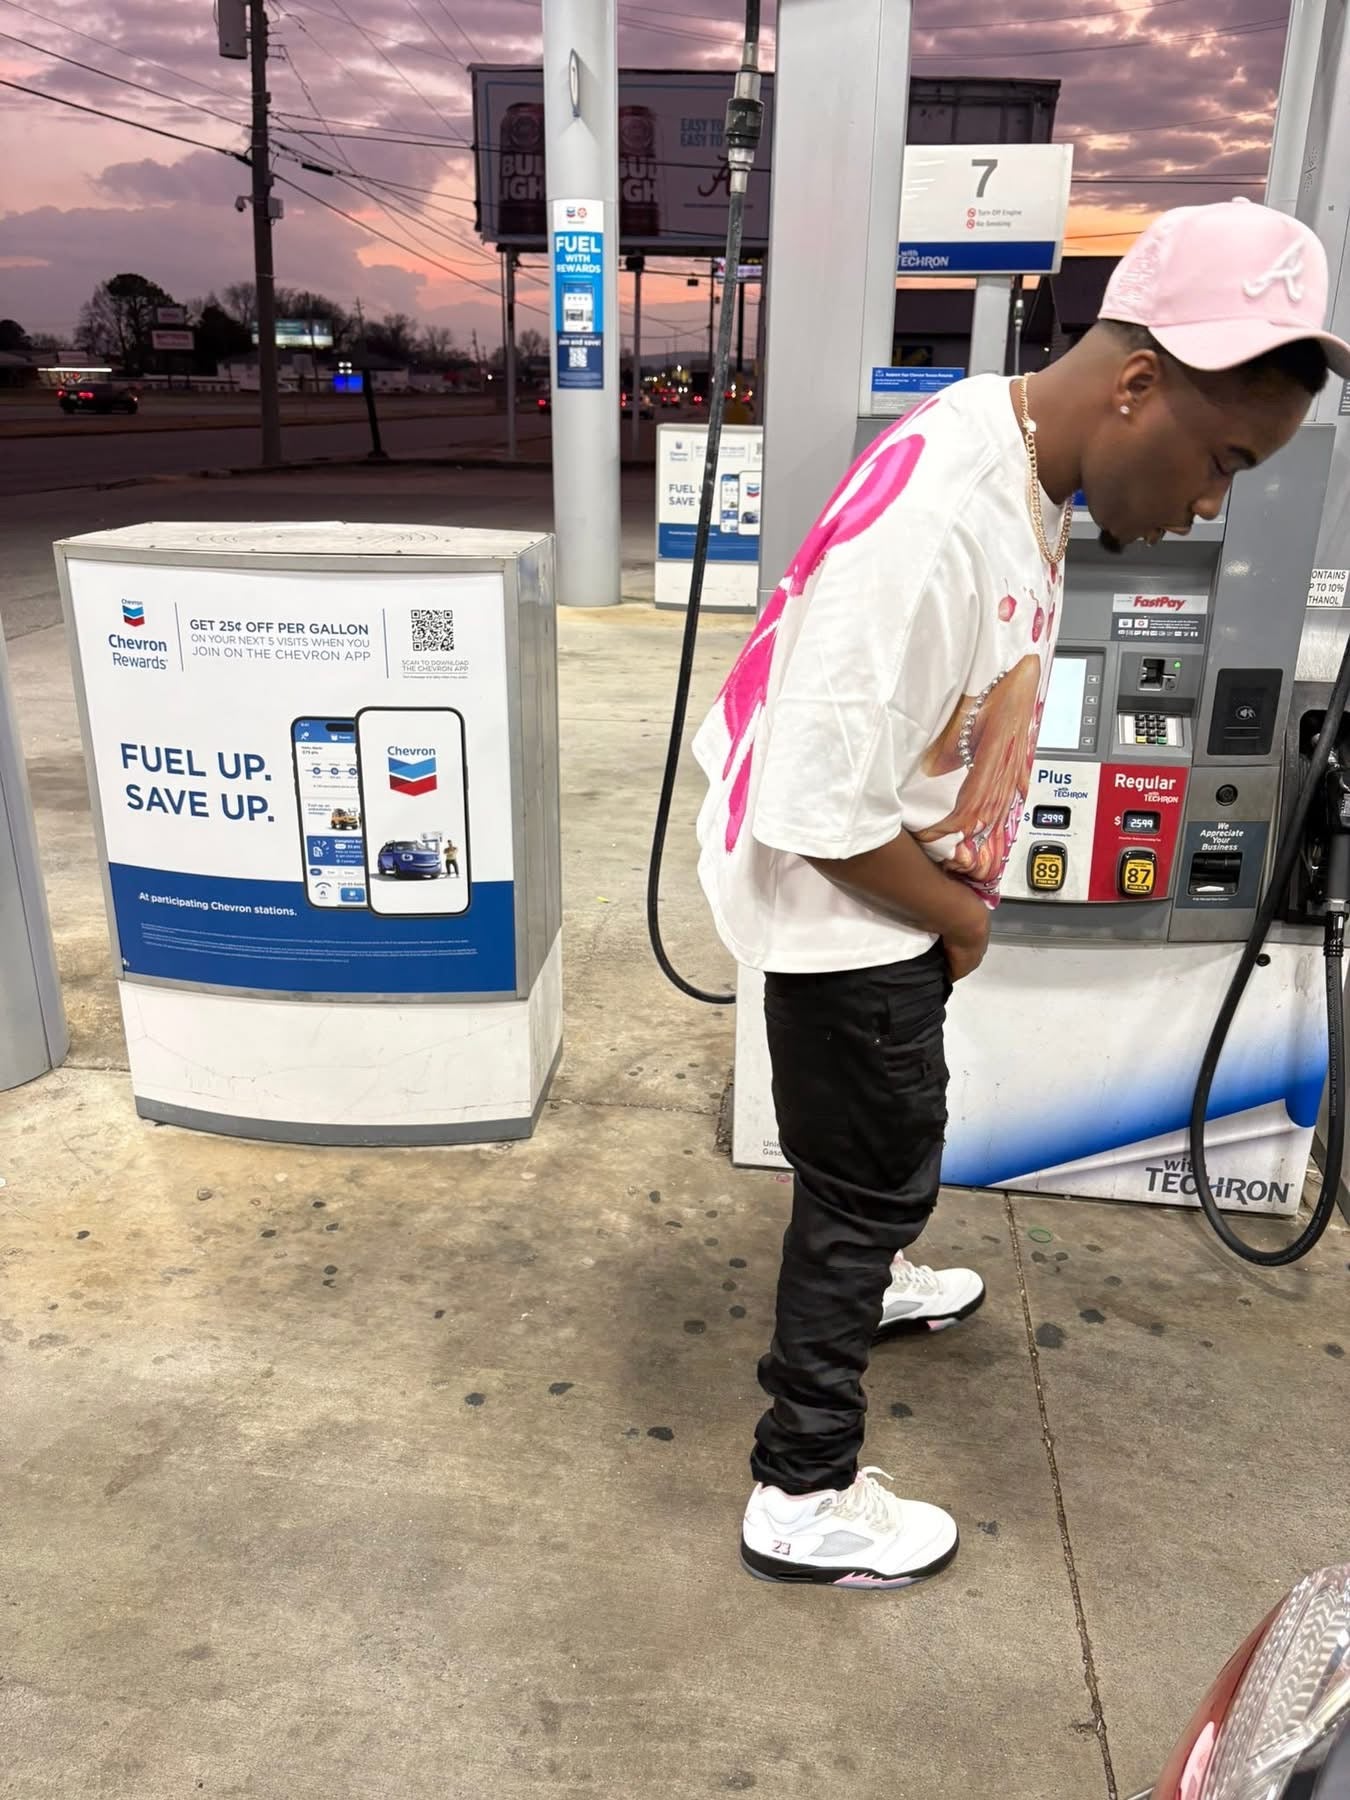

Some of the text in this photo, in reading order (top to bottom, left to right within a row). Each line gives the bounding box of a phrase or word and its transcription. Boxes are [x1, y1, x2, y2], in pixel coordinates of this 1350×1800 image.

[971, 159, 998, 198] 7
[556, 235, 602, 253] FUEL
[565, 254, 591, 263] WITH
[669, 483, 696, 494] FUEL
[669, 497, 695, 507] SAVE
[1311, 570, 1346, 580] ONTAINS
[1316, 582, 1327, 592] TO
[1328, 583, 1345, 593] 10%
[121, 598, 144, 606] Chevron
[1134, 596, 1186, 611] FastPay
[1308, 595, 1339, 605] THANOL
[190, 619, 369, 635] GET 25¢ OFF PER GALLON
[108, 634, 167, 652] Chevron
[191, 634, 370, 648] ON YOUR NEXT 5 VISITS WHEN YOU
[192, 646, 371, 661] JOIN ON THE CHEVRON APP
[112, 652, 168, 670] Rewards
[387, 745, 436, 756] Chevron
[120, 743, 272, 781] FUEL UP.
[1037, 769, 1073, 785] Plus
[1114, 773, 1177, 791] Regular
[1053, 790, 1088, 800] TECHRON
[1144, 794, 1179, 804] TECHRON
[125, 784, 209, 818] SAVE
[221, 793, 275, 822] UP.
[1024, 812, 1031, 822] $
[1114, 815, 1121, 826] $
[1217, 822, 1230, 830] We
[1200, 829, 1245, 838] Appreciate
[1212, 836, 1231, 844] Your
[1201, 843, 1239, 851] Business
[1035, 862, 1060, 879] 89
[1127, 867, 1151, 885] 87
[139, 892, 298, 917] At participating Chevron stations.
[763, 1147, 783, 1156] Gaso
[1164, 1158, 1193, 1172] wit
[771, 1539, 792, 1556] 23
